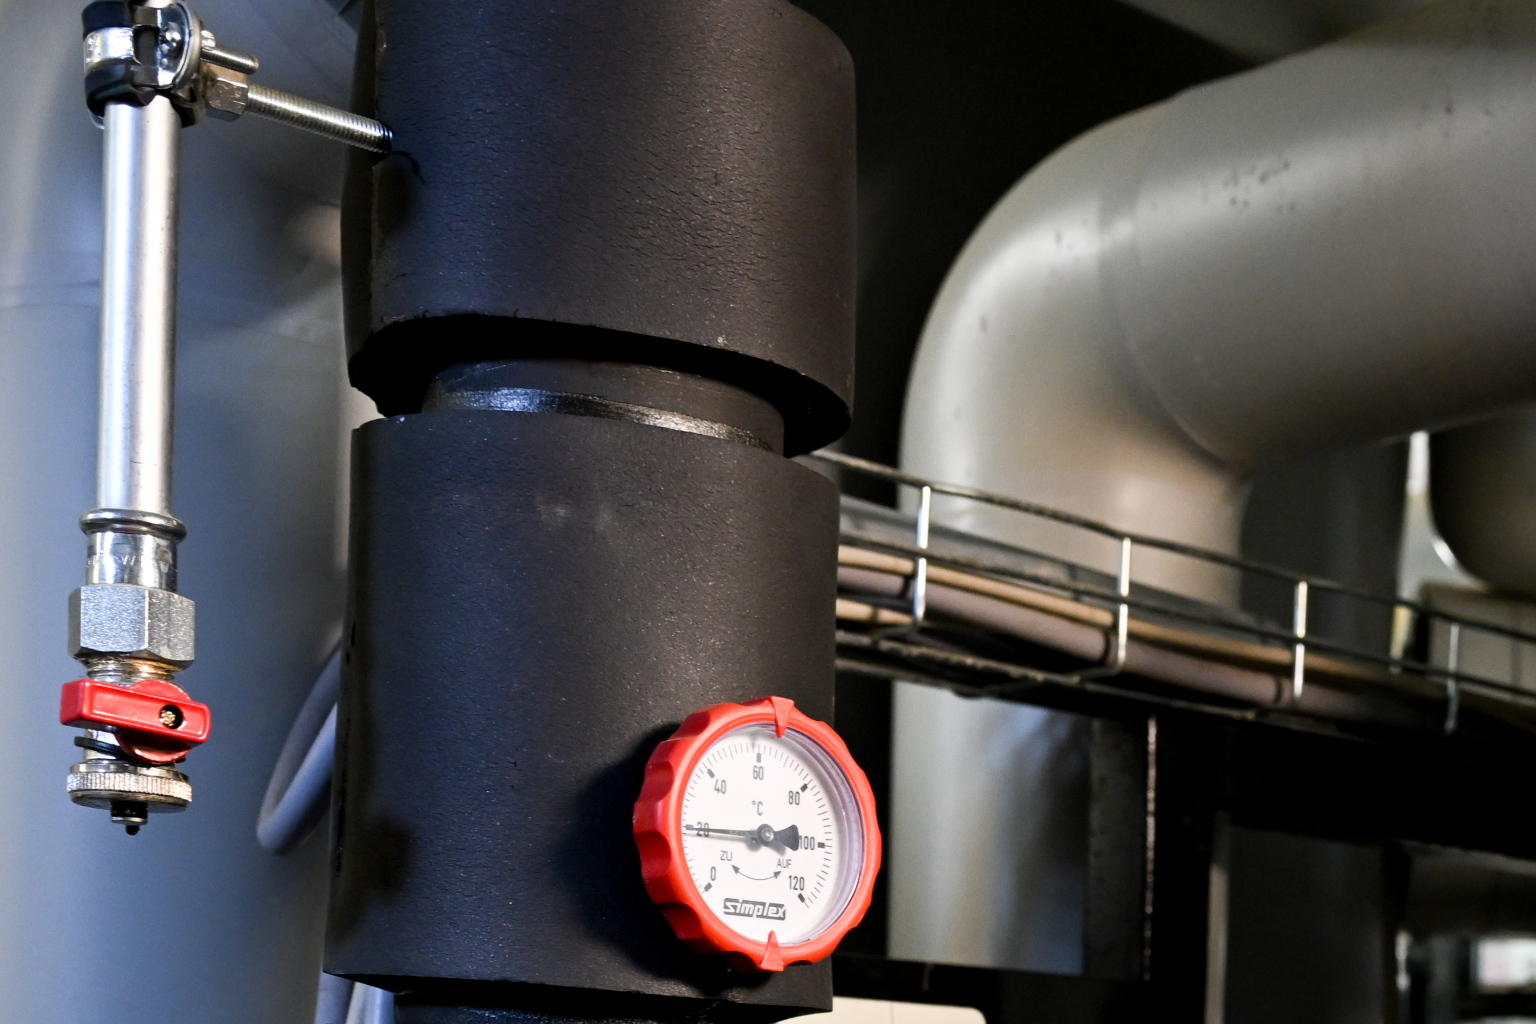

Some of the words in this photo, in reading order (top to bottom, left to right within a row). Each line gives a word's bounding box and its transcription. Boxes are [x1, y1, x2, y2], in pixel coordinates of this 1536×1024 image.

[752, 765, 764, 781] 60
[713, 779, 727, 795] 40
[788, 790, 801, 806] 80
[751, 800, 764, 816] °C
[798, 835, 816, 851] 100
[720, 850, 733, 862] ZU
[776, 858, 793, 869] AUF
[710, 866, 717, 881] 0
[788, 875, 805, 891] 120
